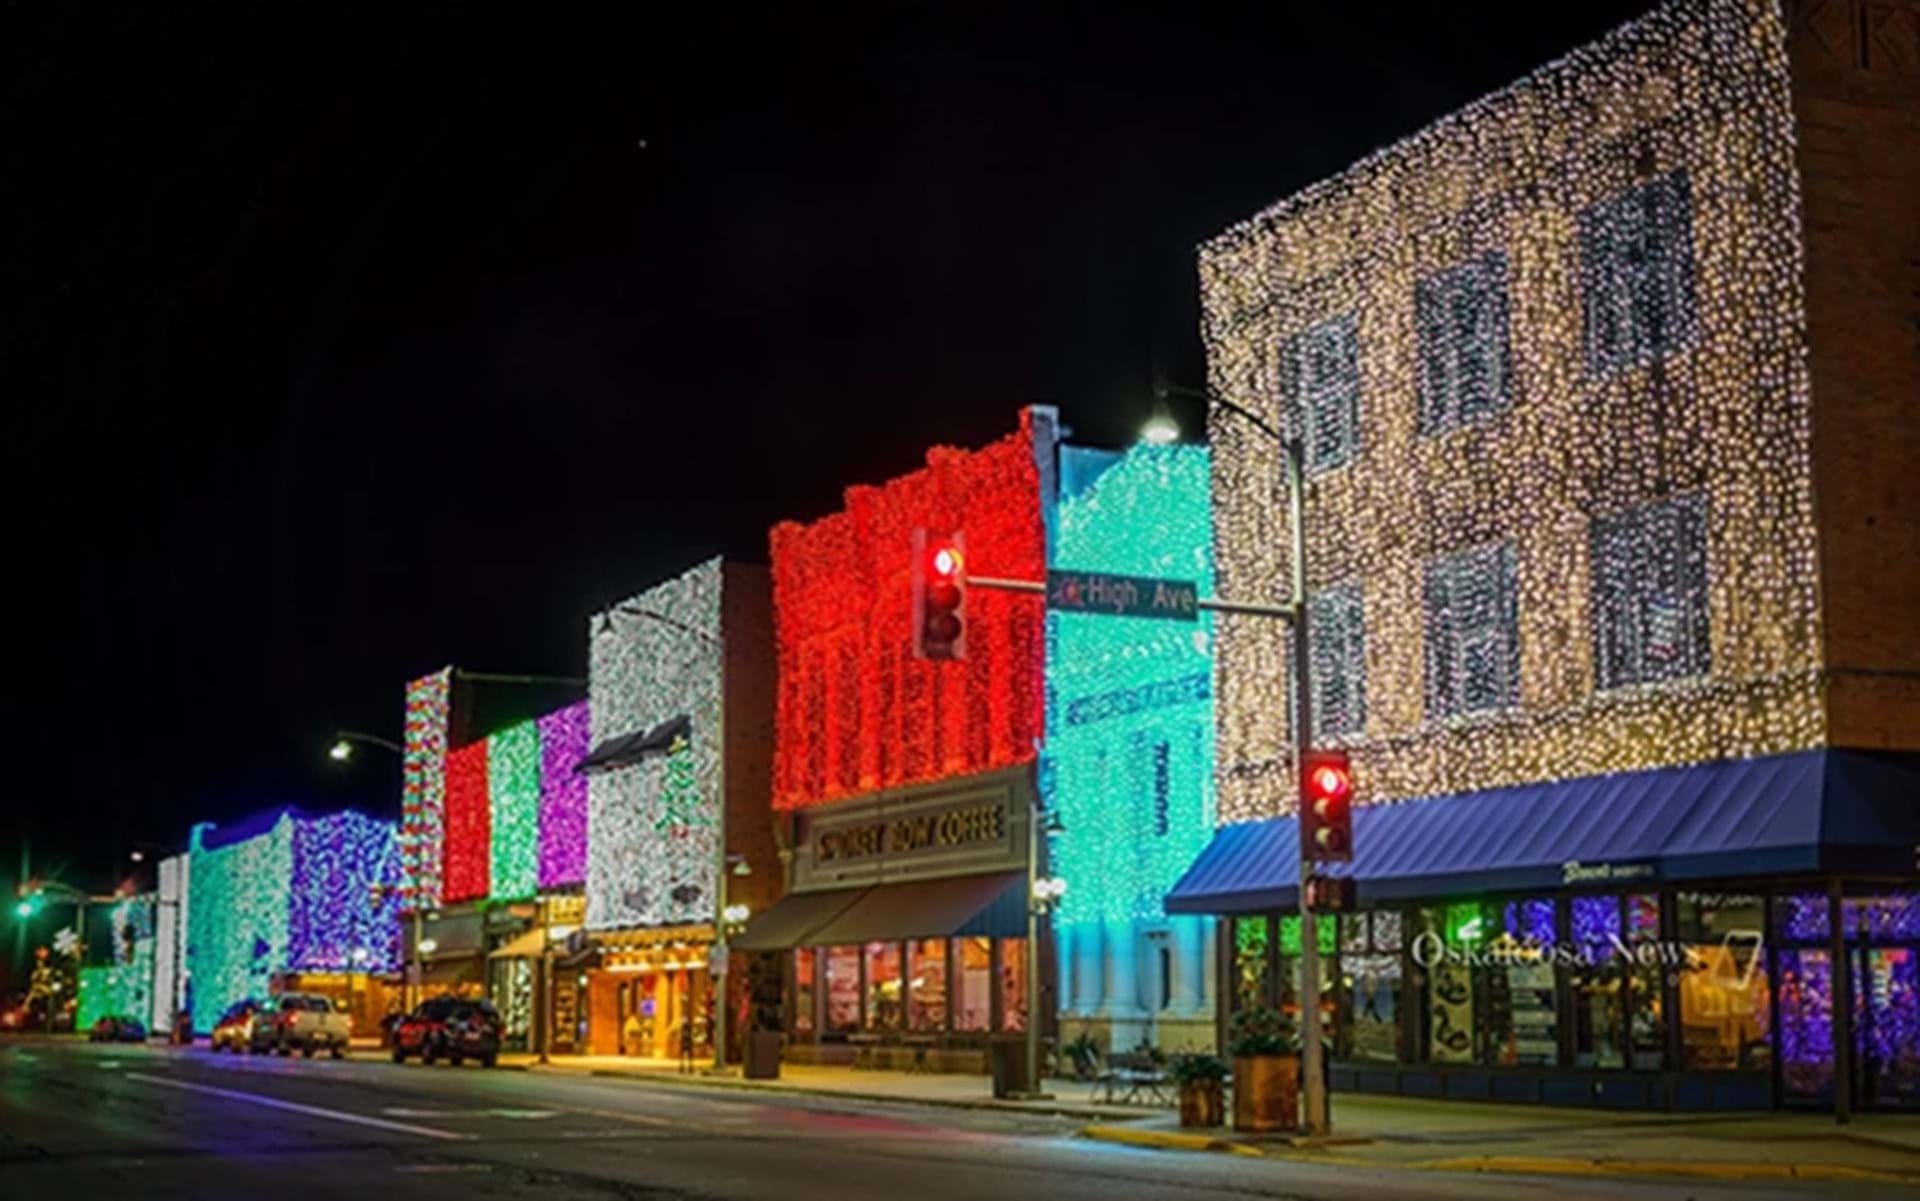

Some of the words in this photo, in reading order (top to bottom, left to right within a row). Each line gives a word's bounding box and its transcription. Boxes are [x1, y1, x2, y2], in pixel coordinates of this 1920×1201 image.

[1088, 576, 1137, 613] High
[1152, 582, 1194, 612] Ave
[937, 804, 1004, 846] COFFEE
